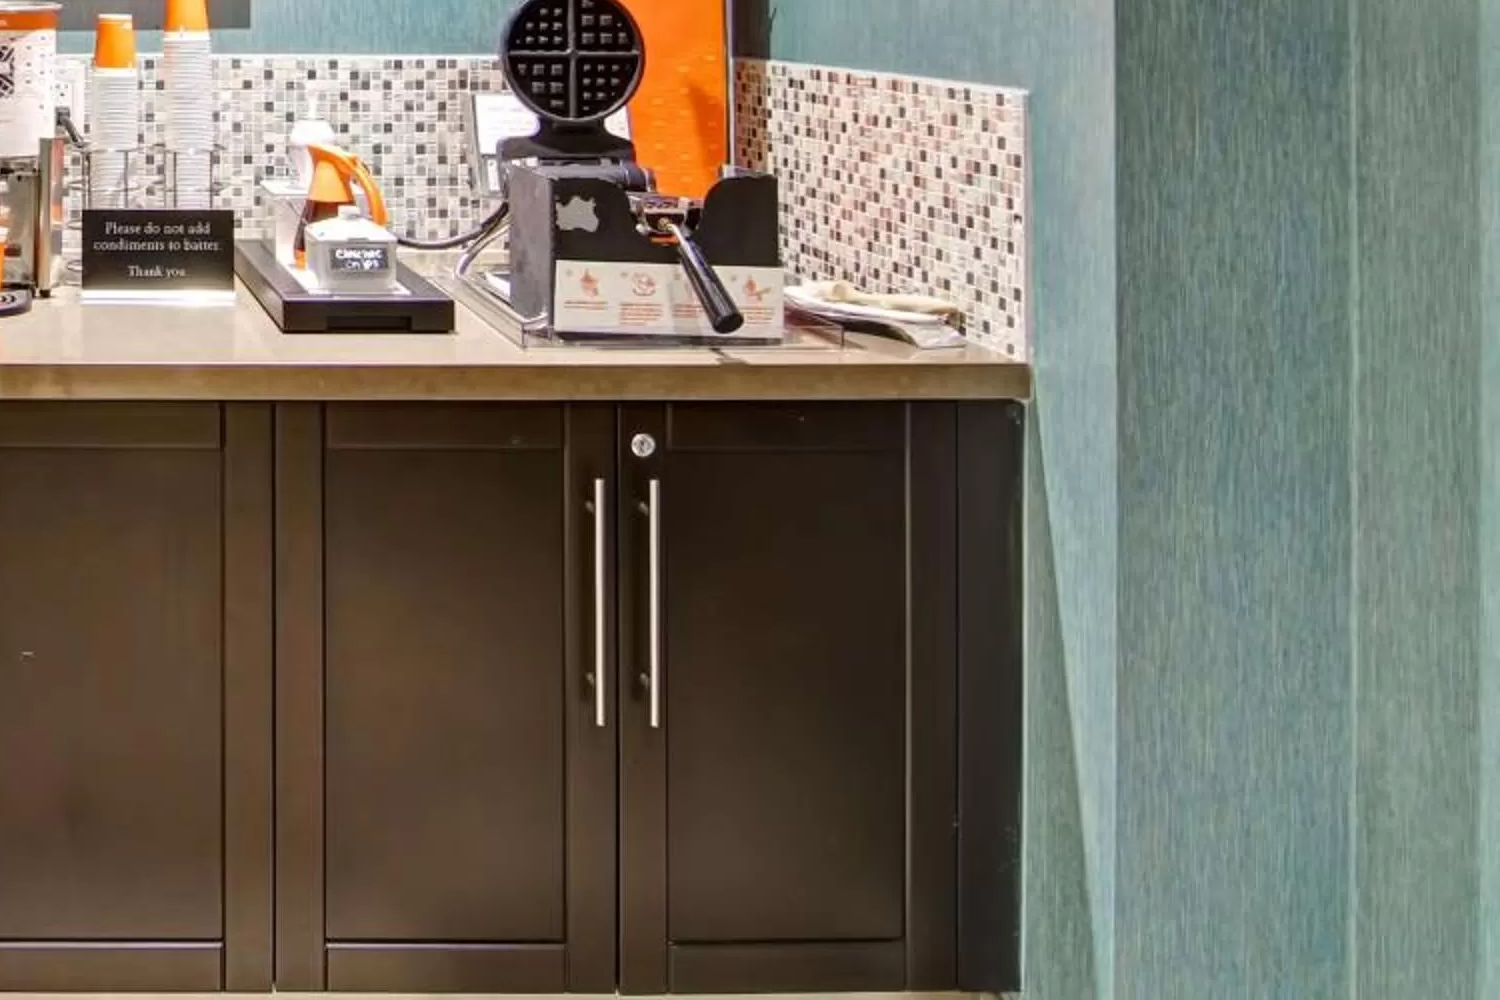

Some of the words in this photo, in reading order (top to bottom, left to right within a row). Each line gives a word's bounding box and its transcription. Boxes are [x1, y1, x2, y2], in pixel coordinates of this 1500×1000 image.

[105, 221, 141, 235] Please
[144, 221, 161, 235] do
[163, 223, 185, 235] not
[187, 221, 211, 235] add
[93, 238, 165, 251] condiments
[168, 240, 181, 251] to
[127, 265, 163, 277] Thank
[165, 268, 186, 279] you
